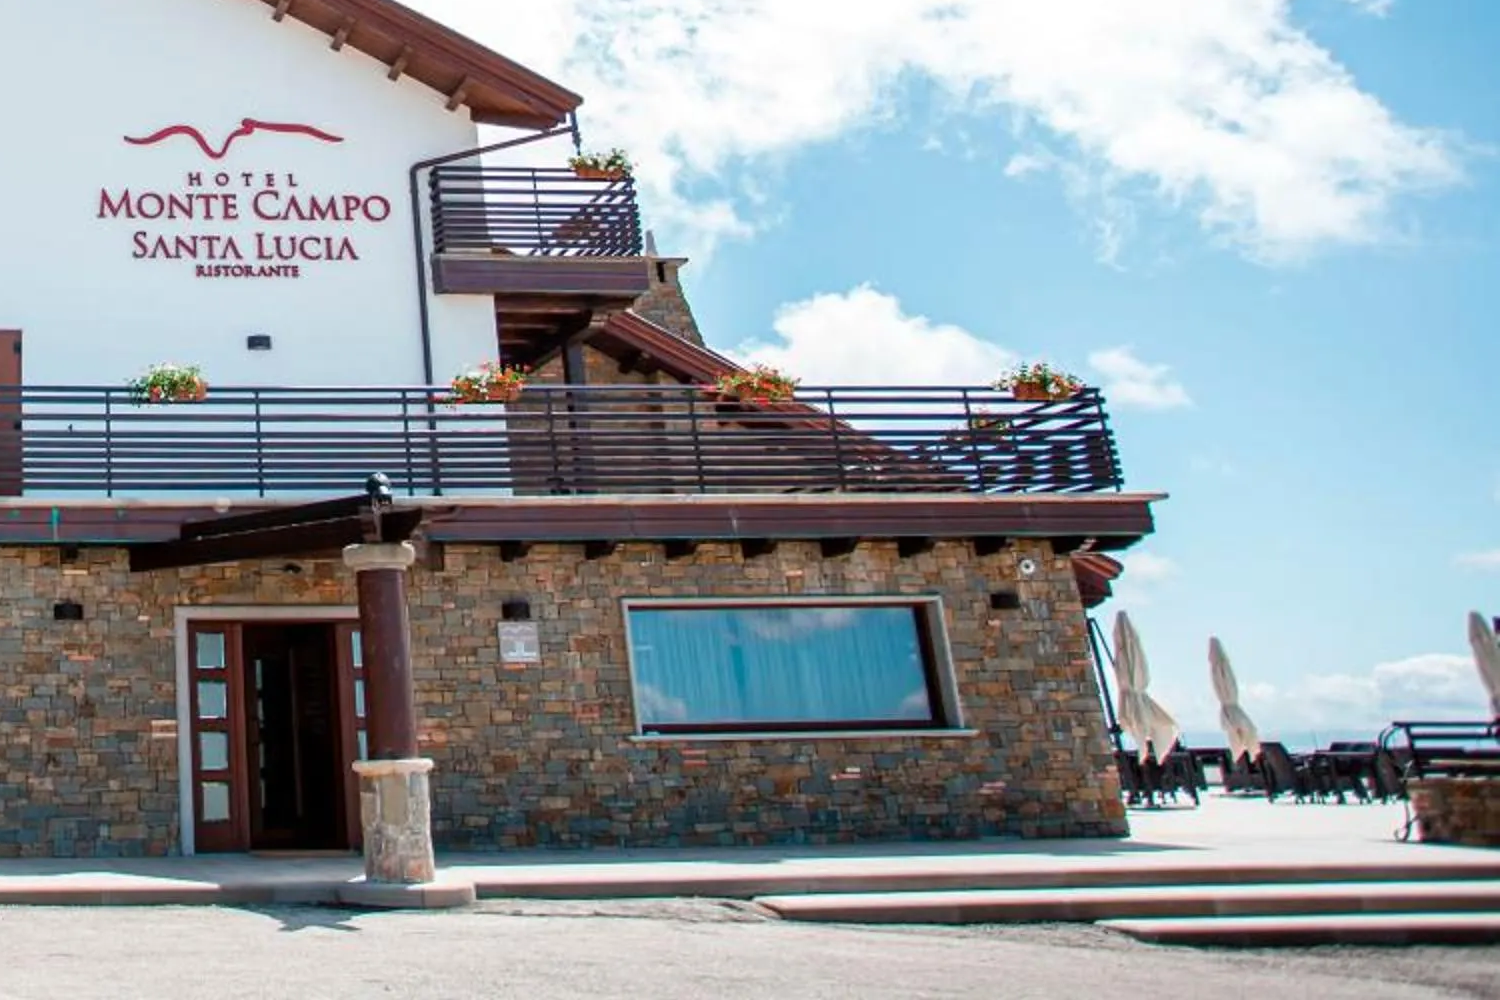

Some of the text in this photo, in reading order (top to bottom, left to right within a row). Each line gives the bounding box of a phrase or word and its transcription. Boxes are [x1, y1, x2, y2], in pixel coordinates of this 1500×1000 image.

[188, 172, 299, 187] HOTEL
[97, 187, 391, 222] MONTE CAMPO
[132, 231, 359, 260] SANTA LUCIA
[195, 265, 300, 278] RISTORANTE
